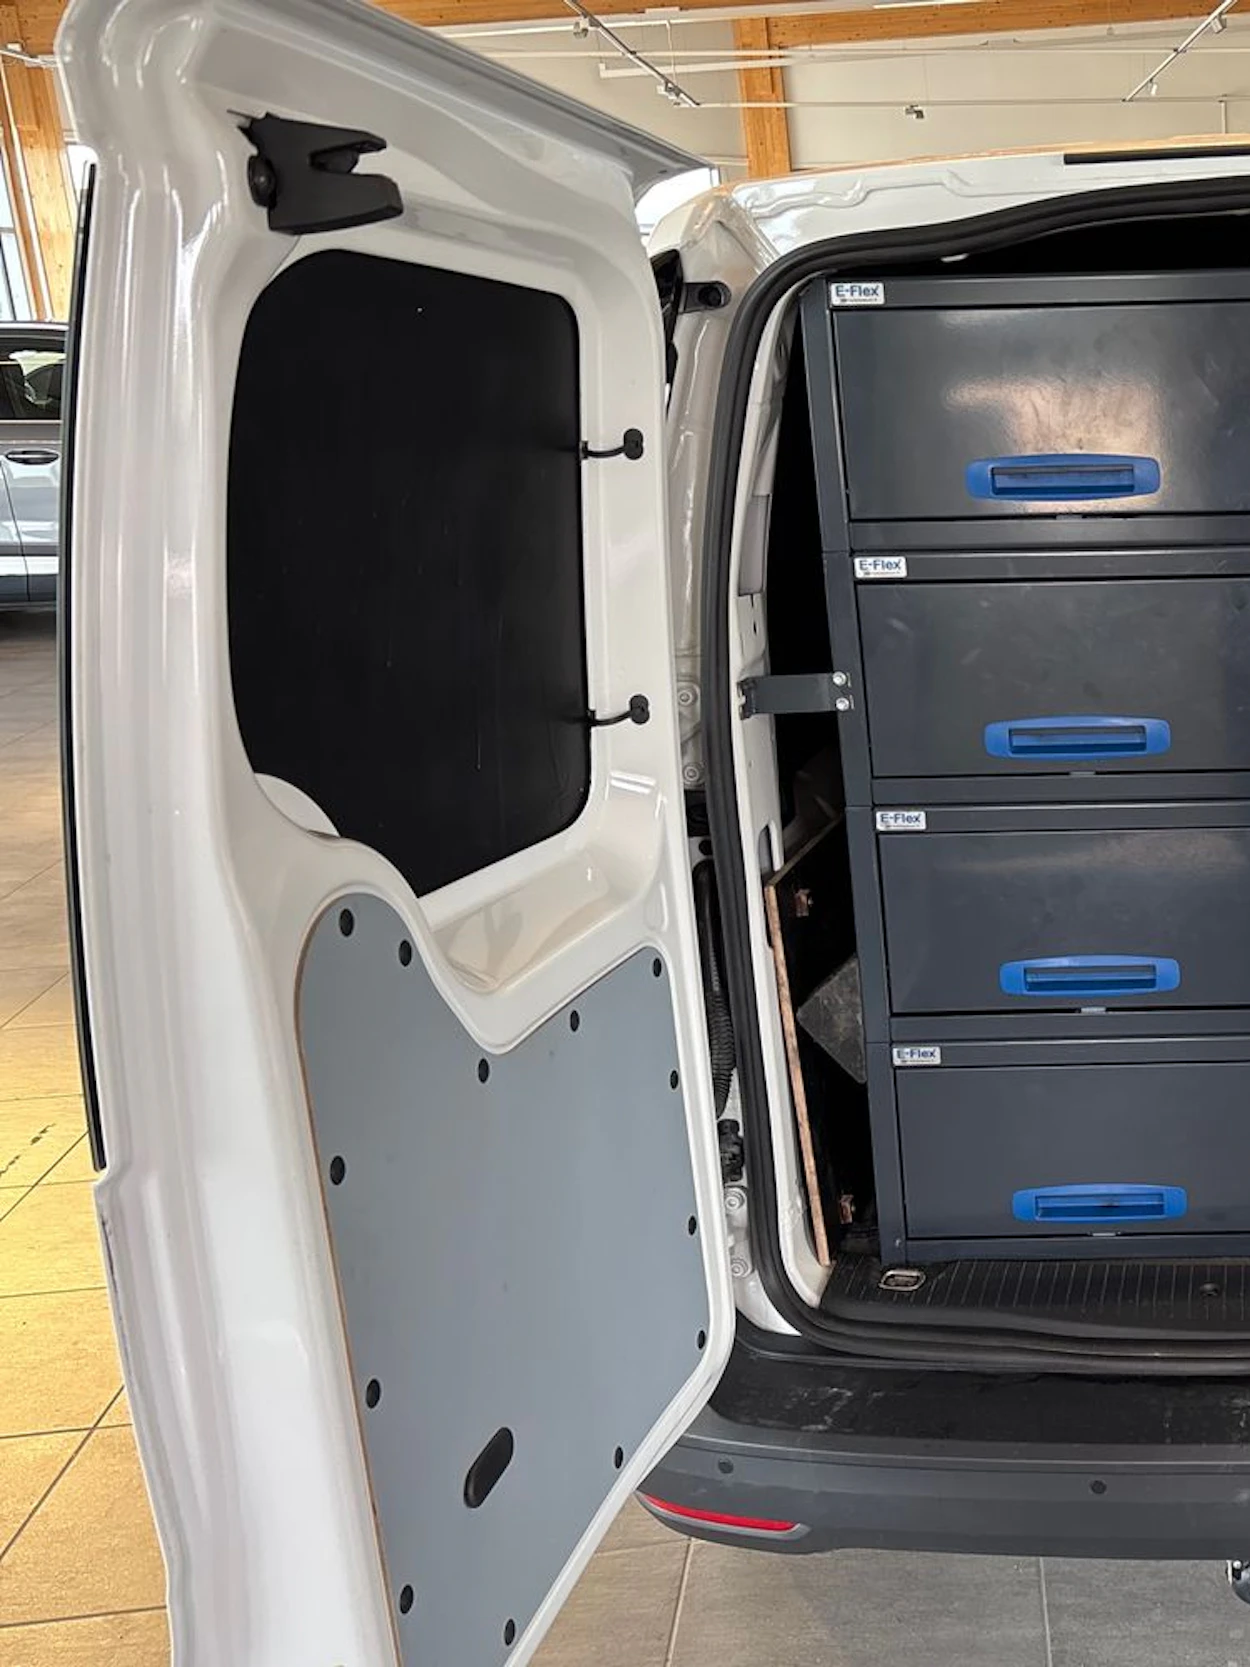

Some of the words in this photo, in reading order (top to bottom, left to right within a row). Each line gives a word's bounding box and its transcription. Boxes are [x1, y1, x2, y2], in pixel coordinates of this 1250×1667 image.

[835, 284, 880, 297] E-Flex
[859, 559, 902, 571] E-Flex
[880, 813, 922, 824] E-Flex
